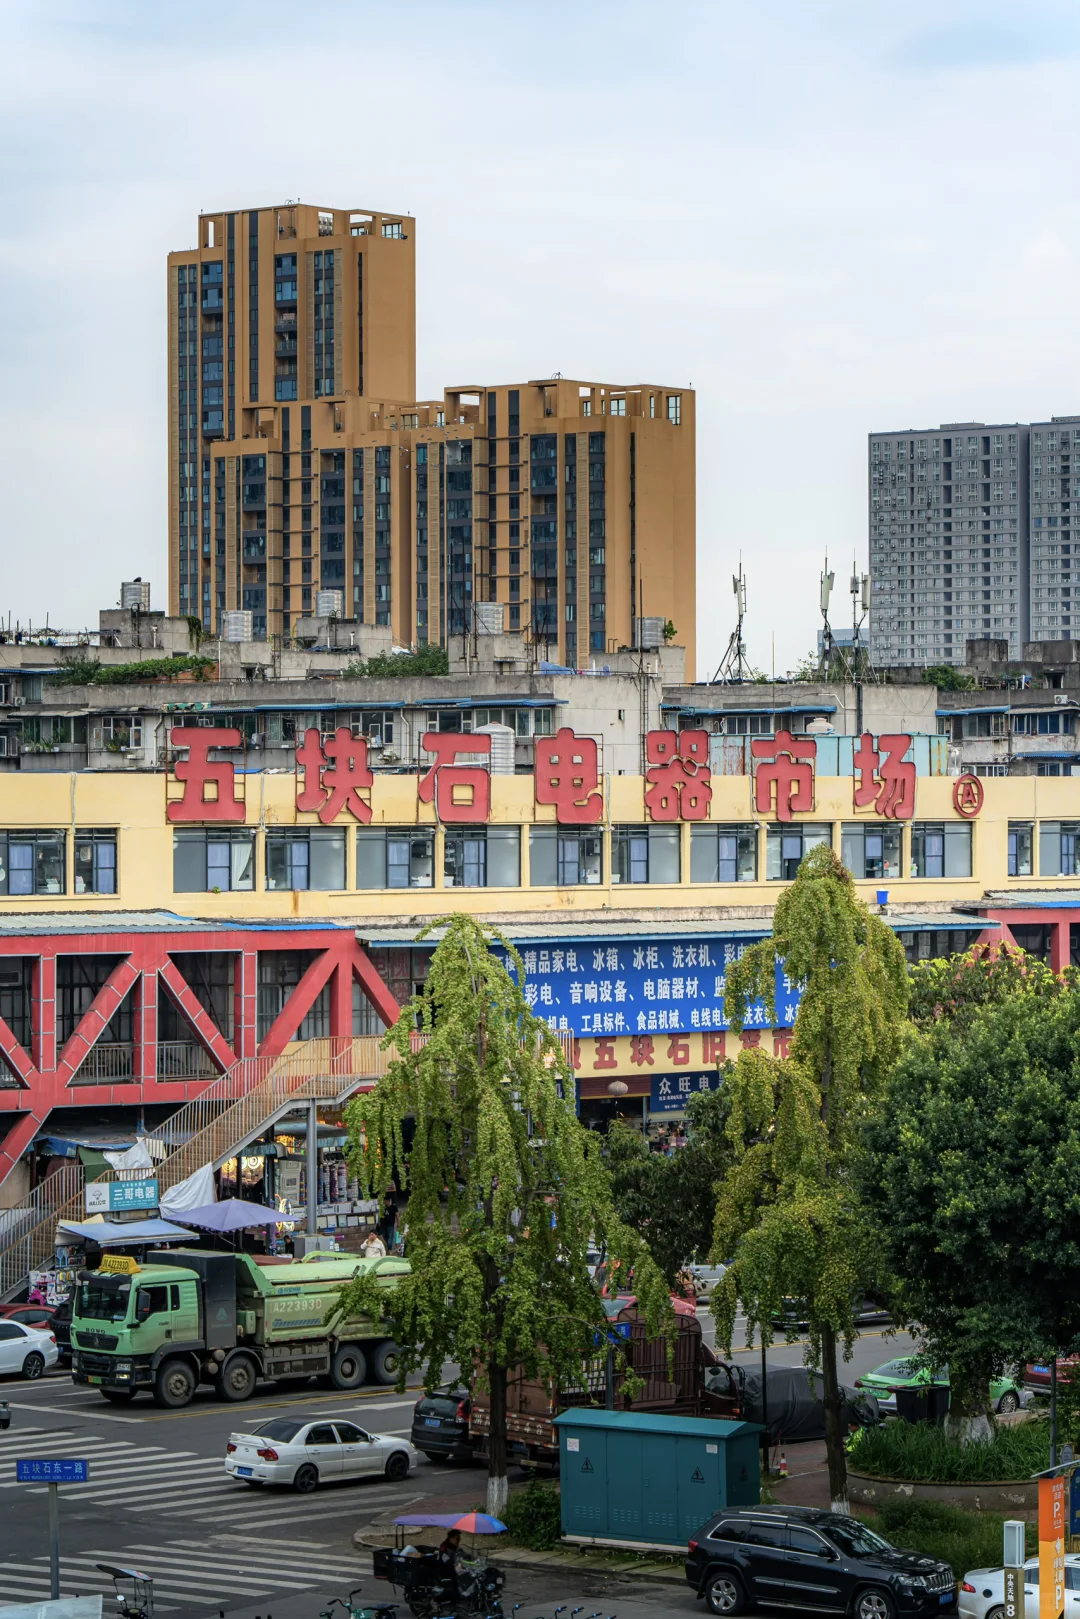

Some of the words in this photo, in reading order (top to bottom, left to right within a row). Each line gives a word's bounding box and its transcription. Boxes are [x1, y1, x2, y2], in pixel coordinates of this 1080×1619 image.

[166, 726, 916, 824] 五块石电器市场
[114, 1187, 155, 1200] 三哥电器
[22, 1461, 83, 1474] 五块石东一路
[1006, 1604, 1015, 1617] 8
